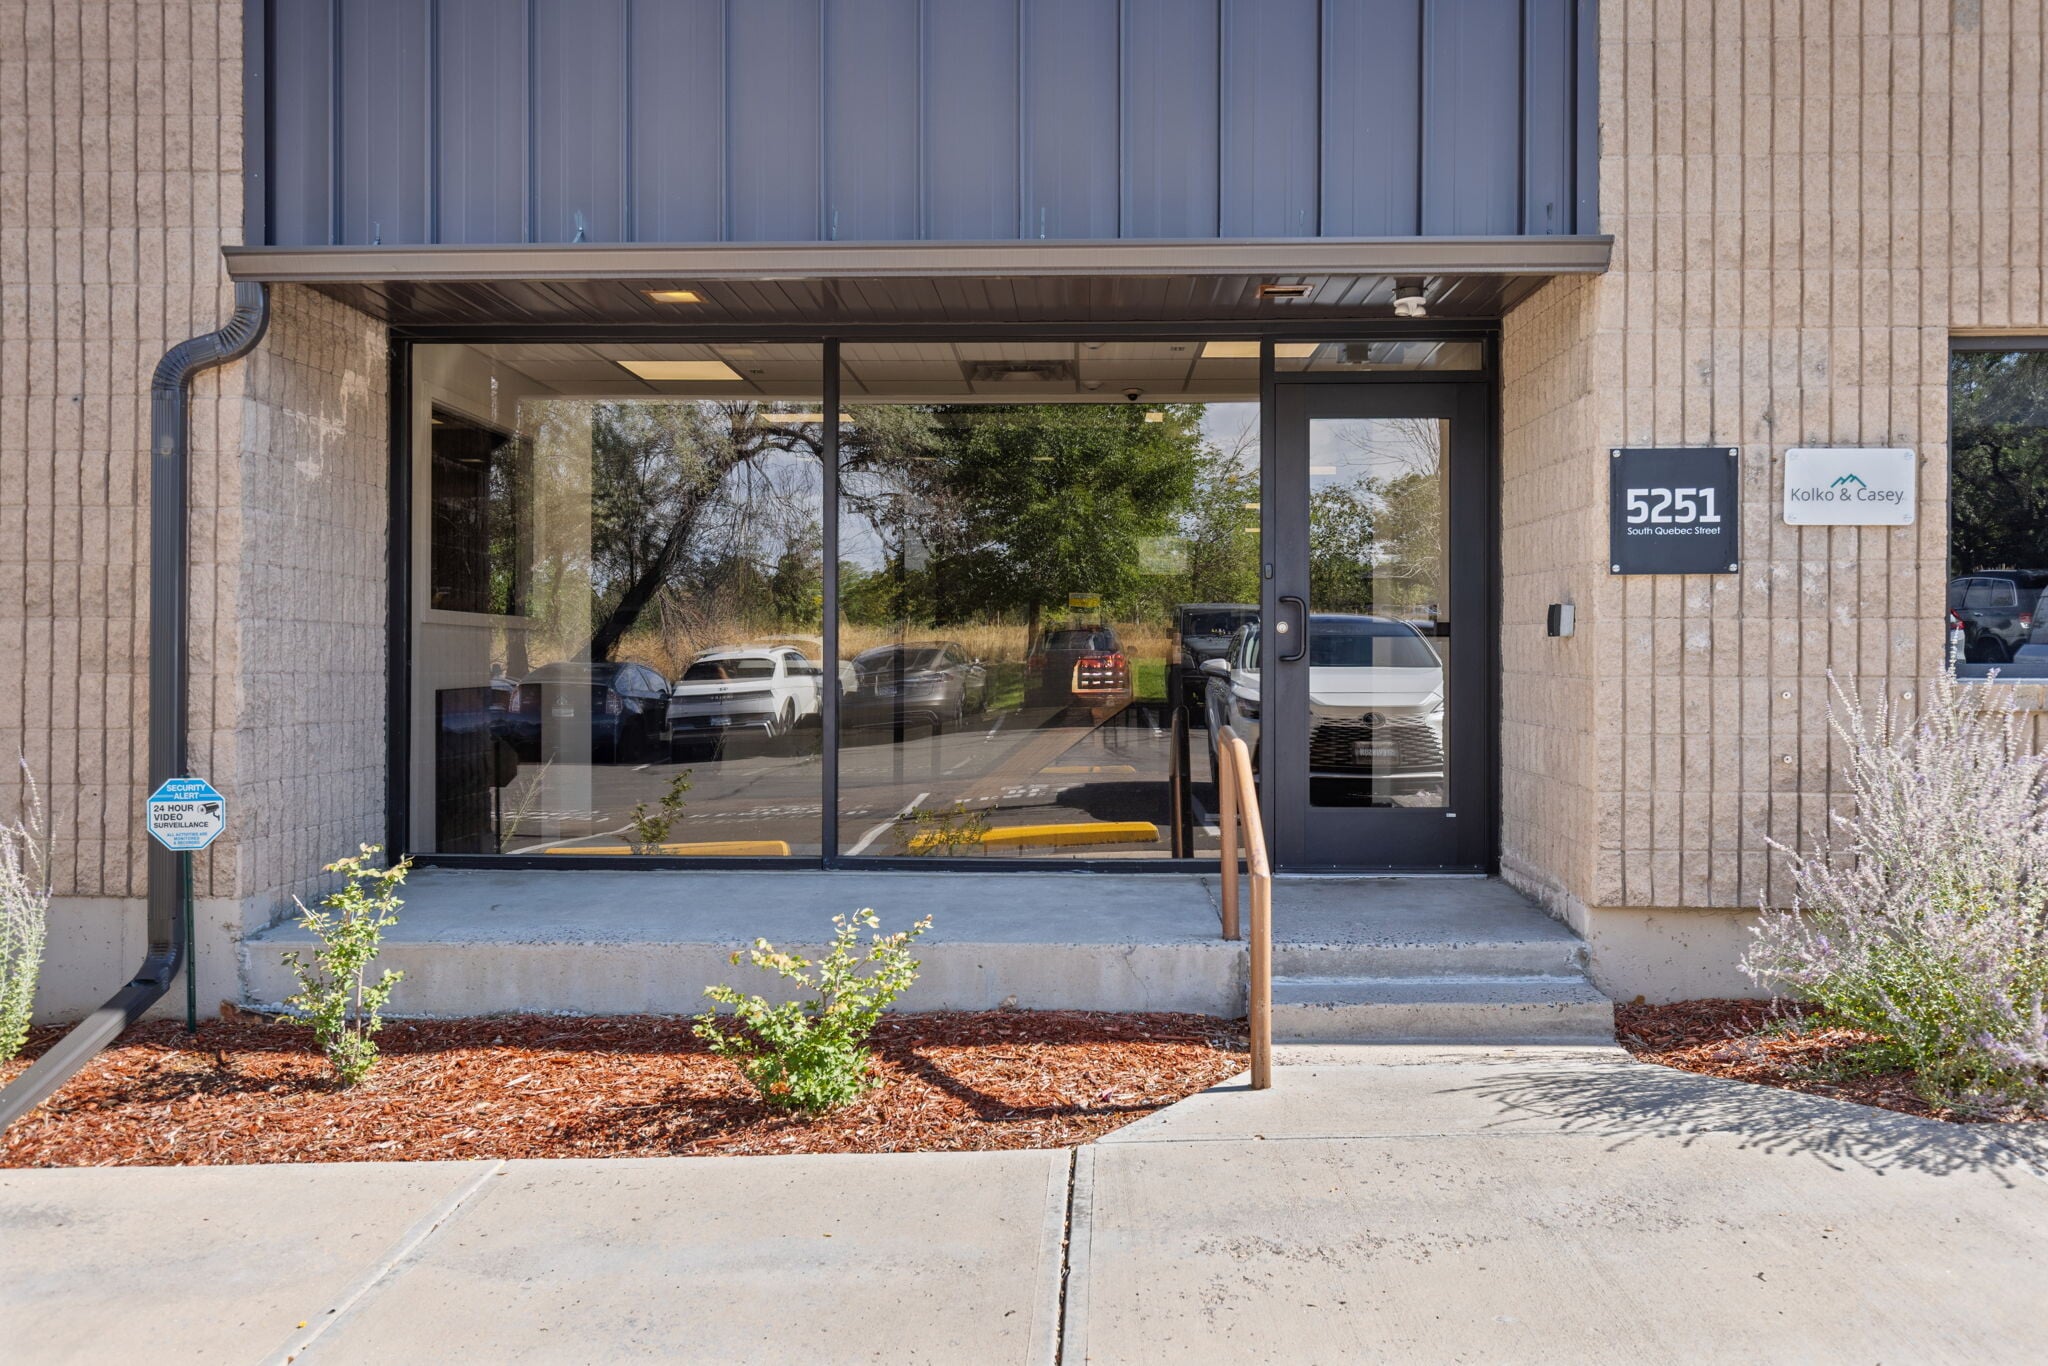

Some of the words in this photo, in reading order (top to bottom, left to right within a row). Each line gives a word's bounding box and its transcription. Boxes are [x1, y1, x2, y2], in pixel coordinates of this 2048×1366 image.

[1790, 487, 1835, 502] Kolko
[1839, 488, 1852, 502] &
[1857, 487, 1904, 505] Casey
[1626, 487, 1721, 524] 5251
[1627, 526, 1653, 536] South
[1654, 526, 1692, 536] Quebec
[1694, 526, 1721, 535] Street
